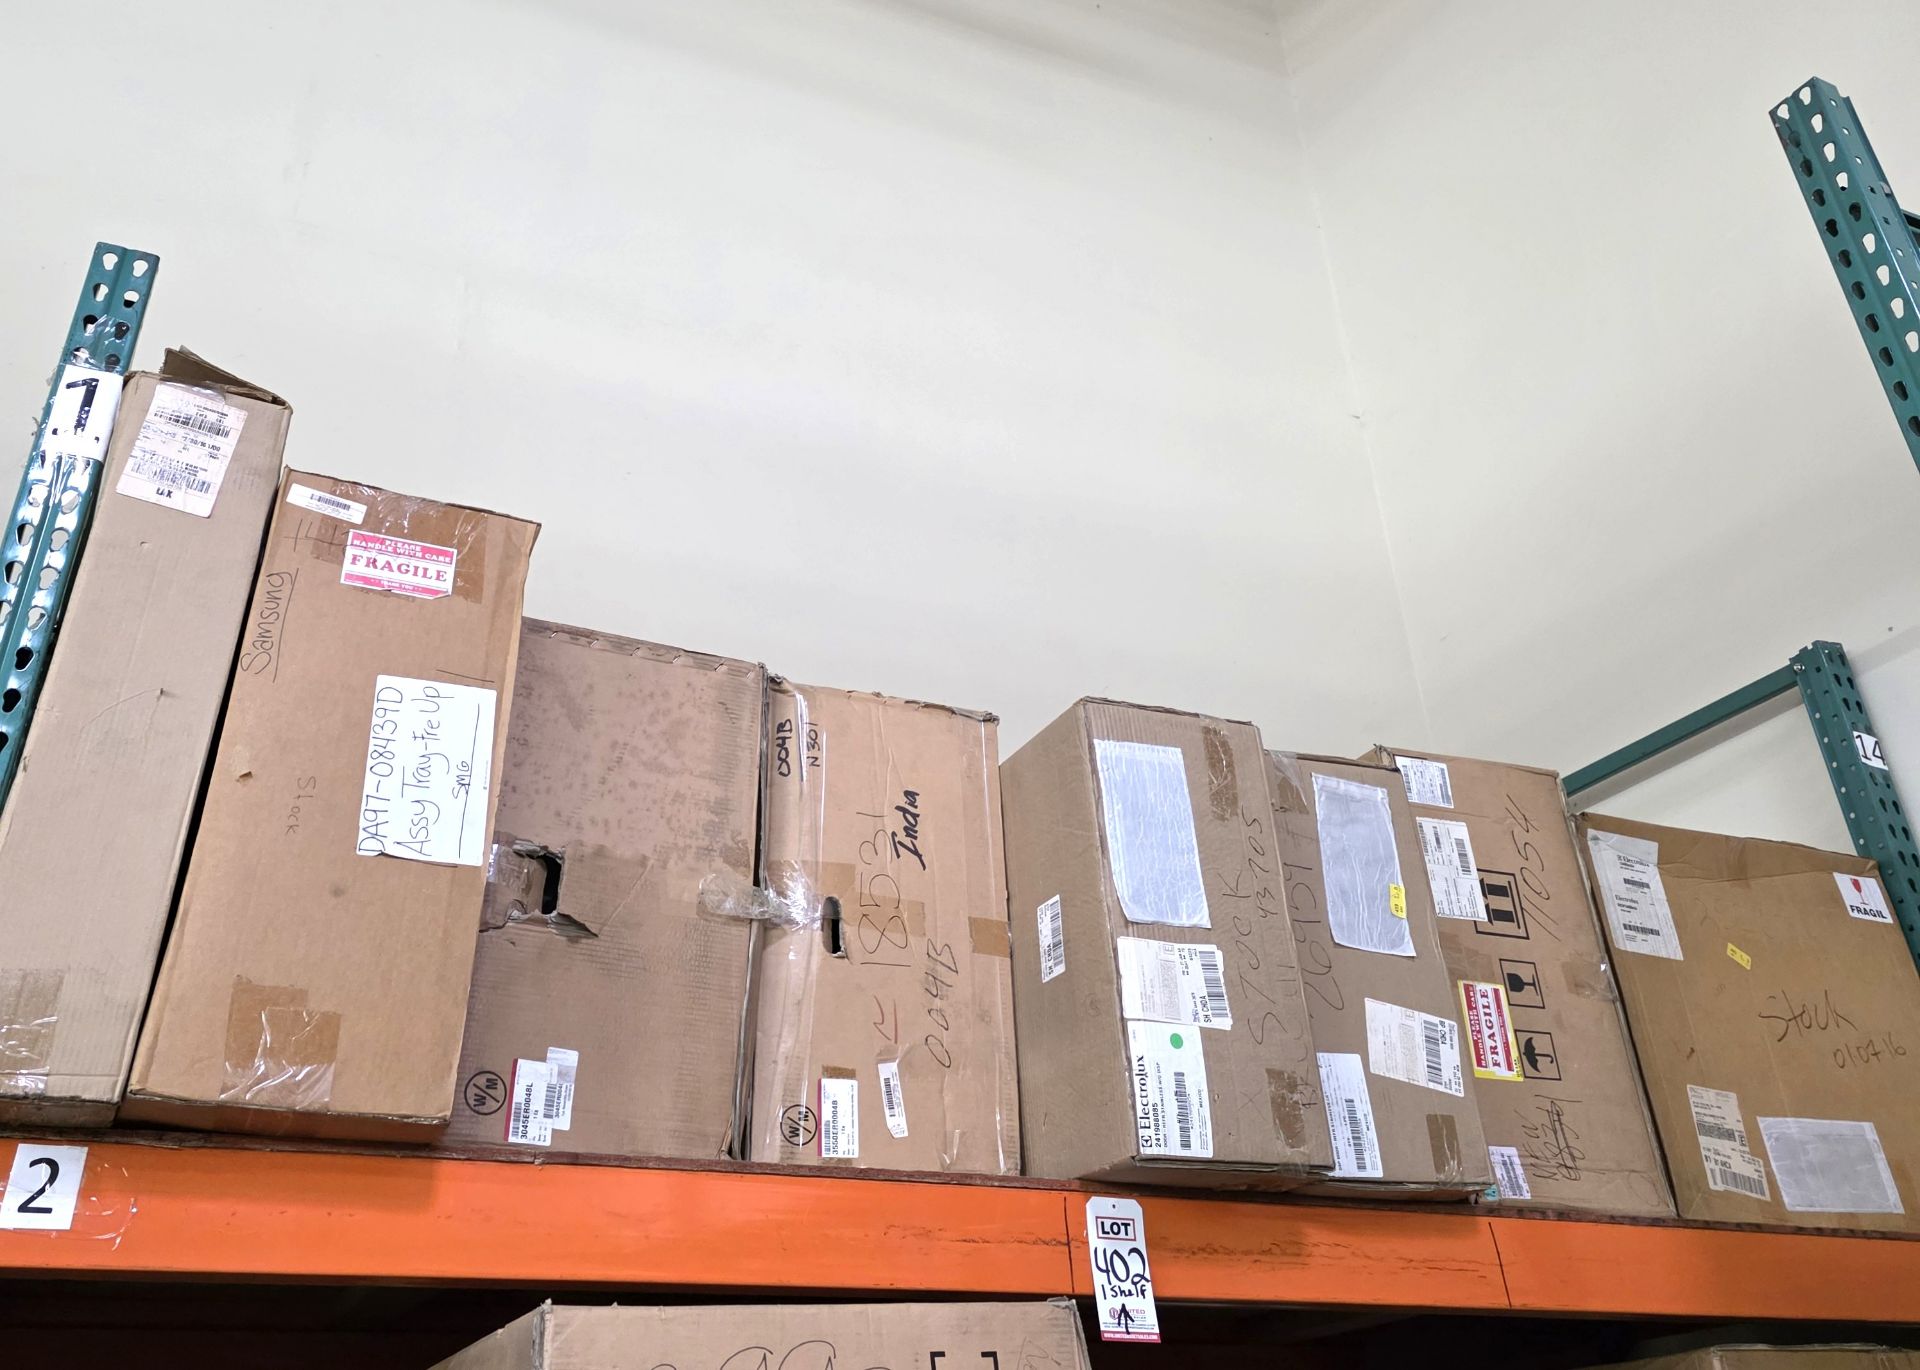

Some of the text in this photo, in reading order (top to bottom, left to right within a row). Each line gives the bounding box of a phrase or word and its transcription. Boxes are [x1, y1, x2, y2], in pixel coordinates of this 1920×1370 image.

[65, 377, 100, 436] 1
[353, 539, 452, 564] HANDLE WITH CARE
[384, 539, 422, 552] PLEASE
[350, 553, 449, 583] FRAGILE
[240, 571, 294, 675] Samsung
[775, 718, 793, 777] 004B
[1855, 735, 1887, 766] 14
[358, 686, 404, 853] DA97-08439D
[890, 789, 927, 872] India
[1849, 904, 1888, 920] FRAGIL
[1469, 1010, 1478, 1040] PLEASE
[1480, 988, 1502, 1069] FRAGILE
[1476, 1032, 1487, 1067] HANDLE
[1135, 1054, 1152, 1130] Electrolux
[1151, 1102, 1162, 1149] 241988085
[17, 1157, 61, 1215] 2
[1100, 1221, 1132, 1237] LOT
[1093, 1247, 1151, 1286] 402
[1101, 1283, 1148, 1301] 1 Shelf
